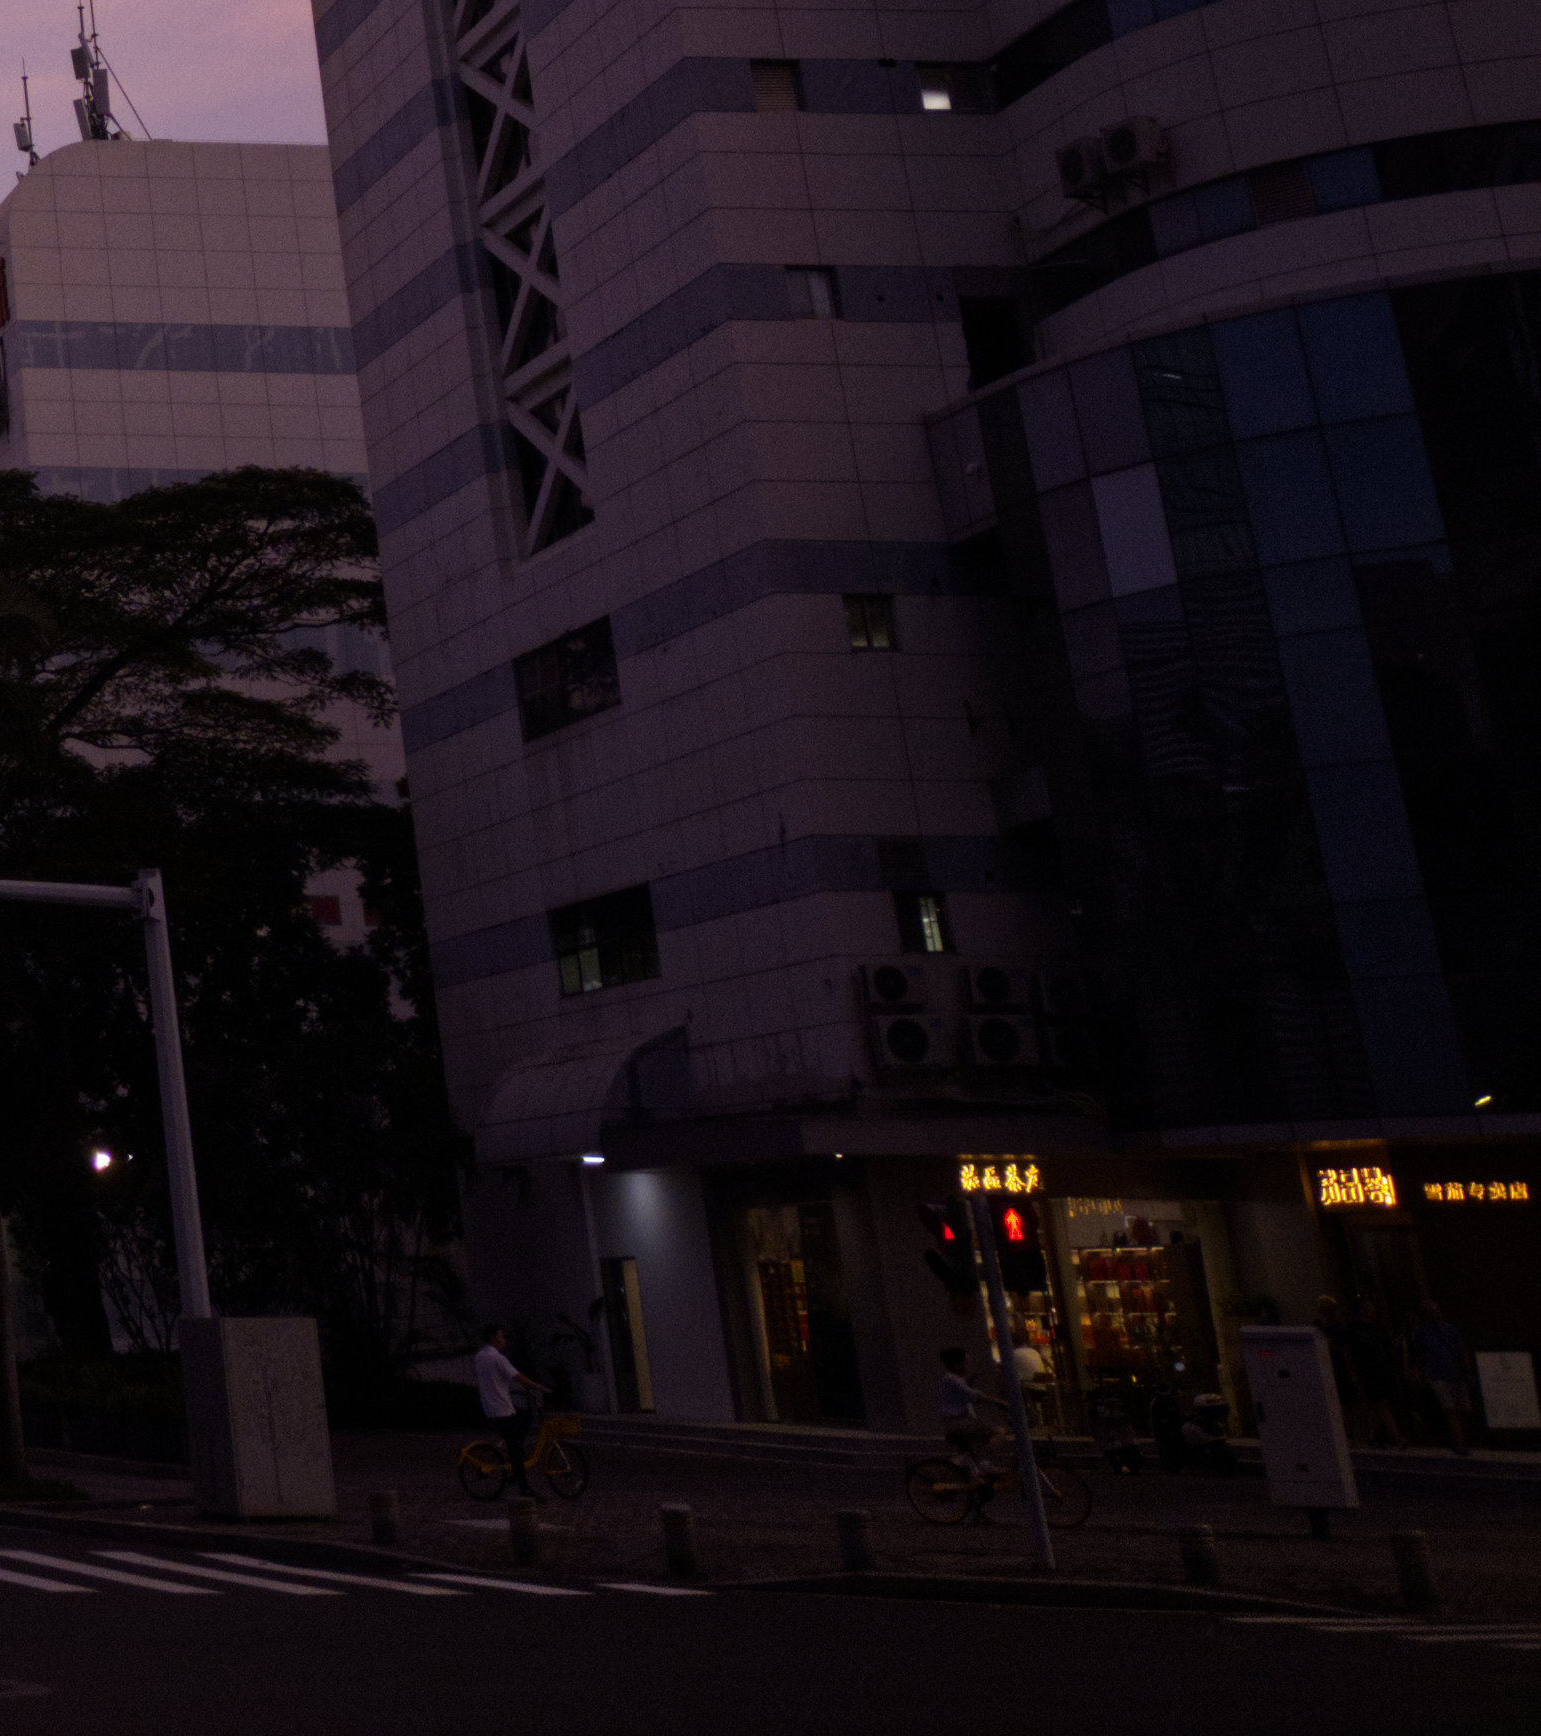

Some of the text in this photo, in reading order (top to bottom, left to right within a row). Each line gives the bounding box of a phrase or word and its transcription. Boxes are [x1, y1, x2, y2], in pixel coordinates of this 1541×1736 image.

[1423, 1181, 1530, 1201] 雪茄专卖店
